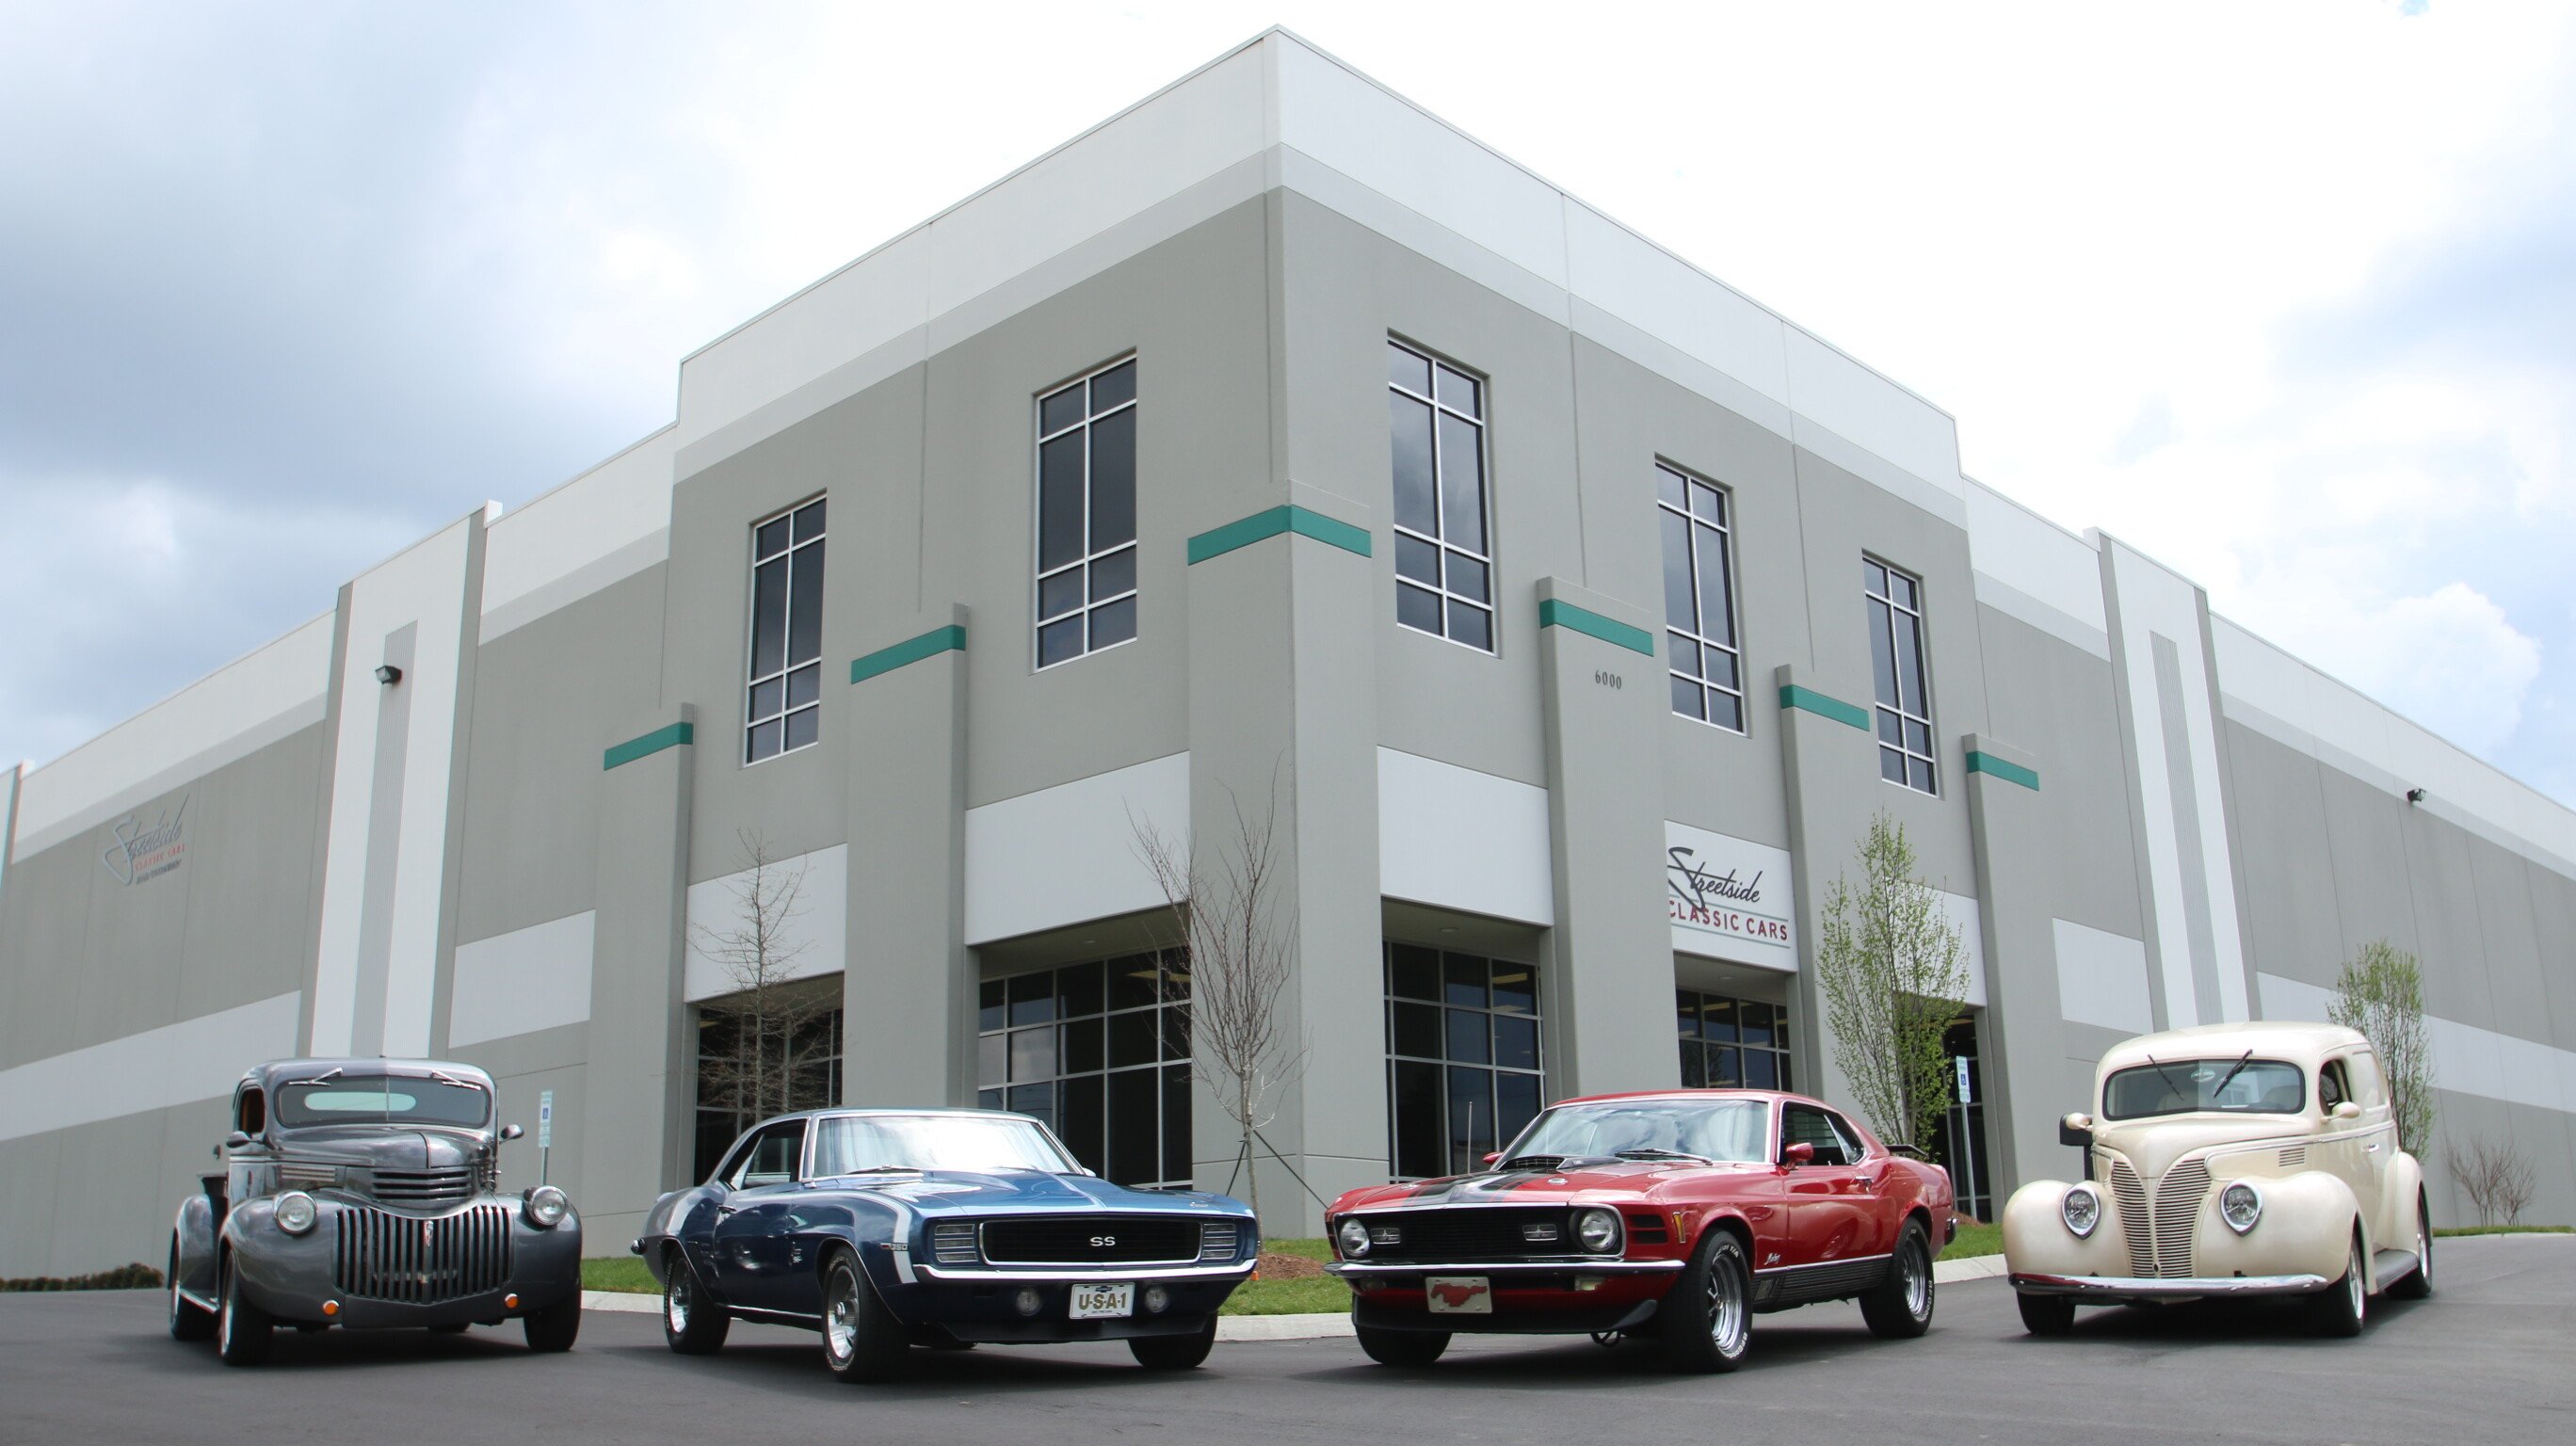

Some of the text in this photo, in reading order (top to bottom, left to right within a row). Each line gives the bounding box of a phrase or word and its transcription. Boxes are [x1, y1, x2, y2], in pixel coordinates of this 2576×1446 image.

[1595, 669, 1621, 689] 6000
[1666, 846, 1763, 912] Streetside
[1746, 917, 1788, 940] CARS
[1089, 1236, 1116, 1246] SS
